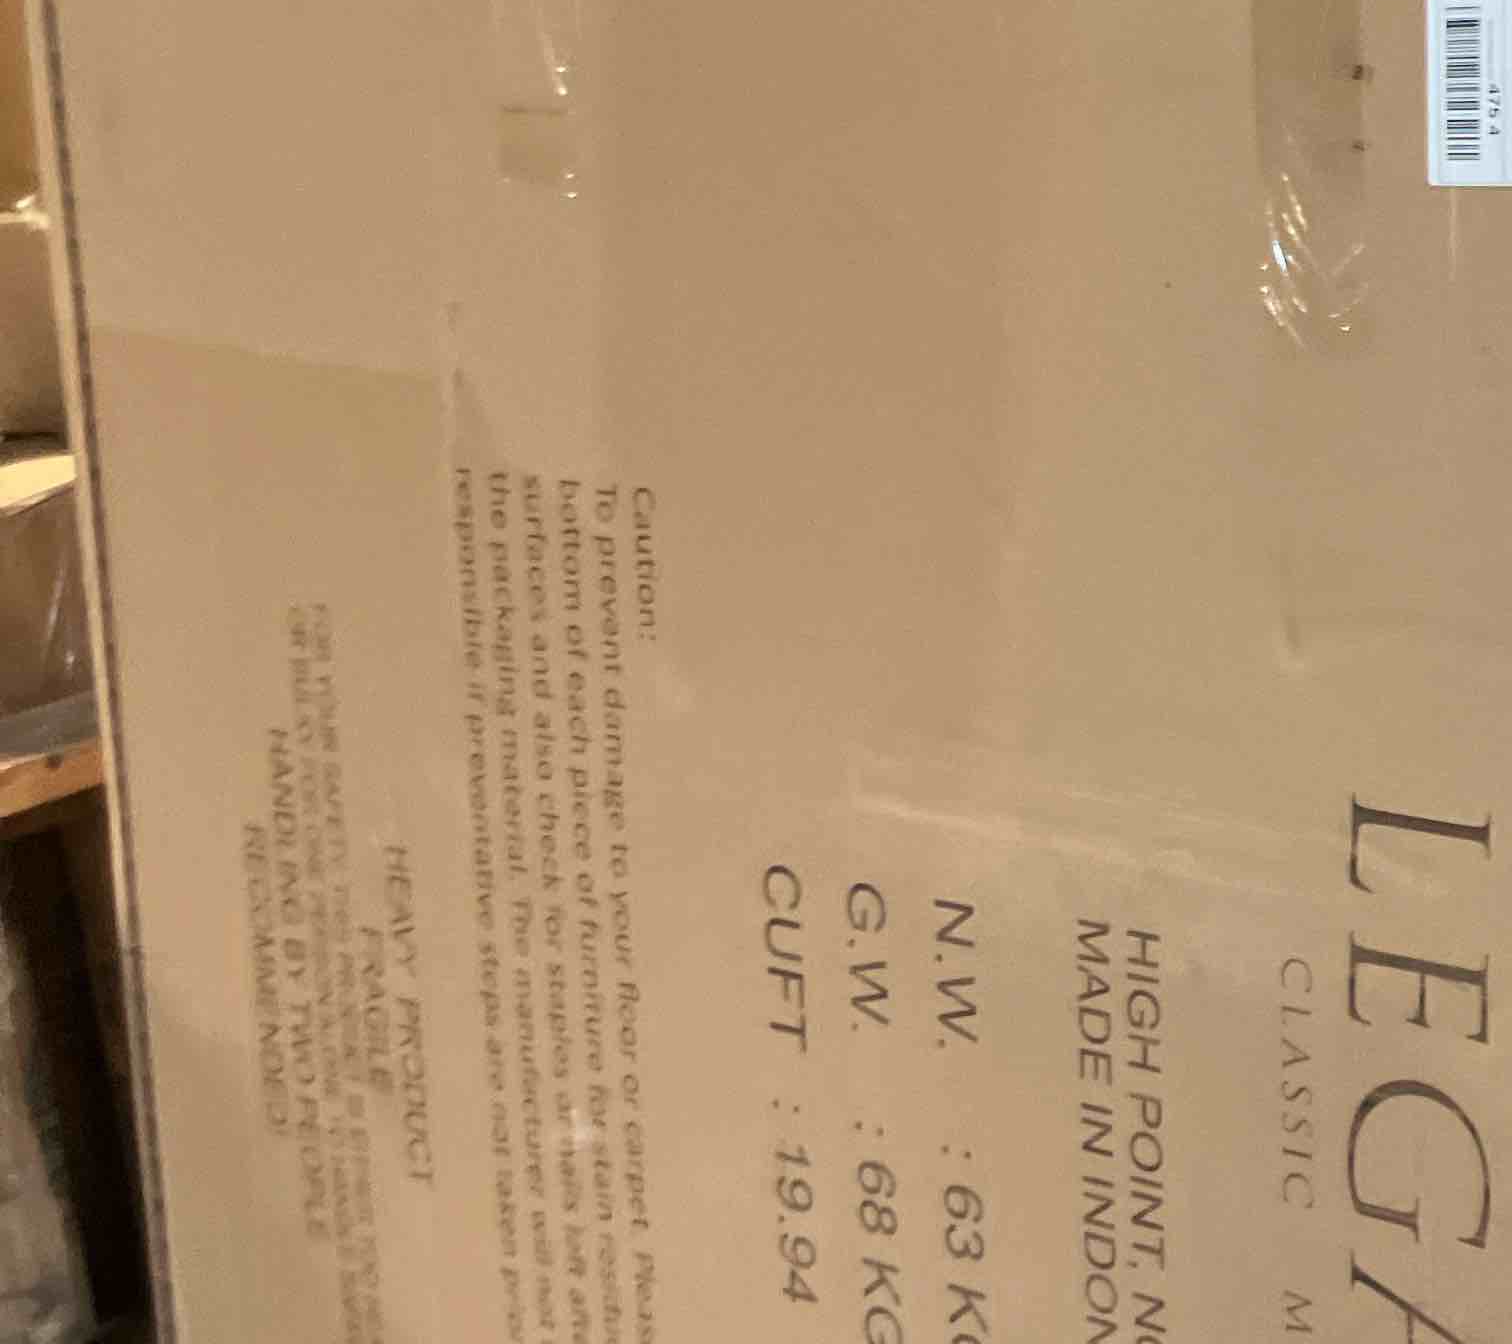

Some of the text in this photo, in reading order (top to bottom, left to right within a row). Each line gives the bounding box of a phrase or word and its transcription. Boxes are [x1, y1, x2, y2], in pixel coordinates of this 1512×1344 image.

[486, 471, 513, 530] the
[522, 473, 549, 624] surfaces
[558, 479, 585, 612] bottom
[594, 484, 619, 524] To
[453, 467, 485, 670] responsible
[593, 534, 622, 676] prevent
[631, 486, 659, 641] Caution:
[487, 540, 520, 719] packaging
[532, 633, 554, 702] and
[566, 623, 590, 663] of
[533, 710, 556, 782] also
[566, 671, 593, 756] each
[601, 687, 629, 832] damage
[535, 791, 565, 894] check
[567, 765, 596, 862] piece
[609, 842, 631, 879] to
[544, 902, 567, 953] for
[576, 871, 600, 909] of
[608, 890, 635, 969] your
[577, 918, 605, 1073] furniture
[761, 862, 809, 1054] CUFT
[844, 881, 891, 1034] G.W.
[932, 897, 979, 1051] N.W.
[1075, 917, 1114, 1085] MADE
[1125, 927, 1164, 1075] HIGH
[383, 844, 436, 1192] HEAVY PRODUCT
[546, 961, 574, 1081] staples
[615, 980, 641, 1064] floor
[587, 1083, 611, 1130] for
[619, 1072, 640, 1110] or
[1079, 1100, 1115, 1157] IN
[1277, 956, 1318, 1212] CLASSIC
[591, 1143, 616, 1223] stain
[772, 1144, 819, 1305] 19.94
[856, 1159, 898, 1237] 68
[941, 1183, 985, 1260] 63
[1126, 1090, 1167, 1271] POINT,
